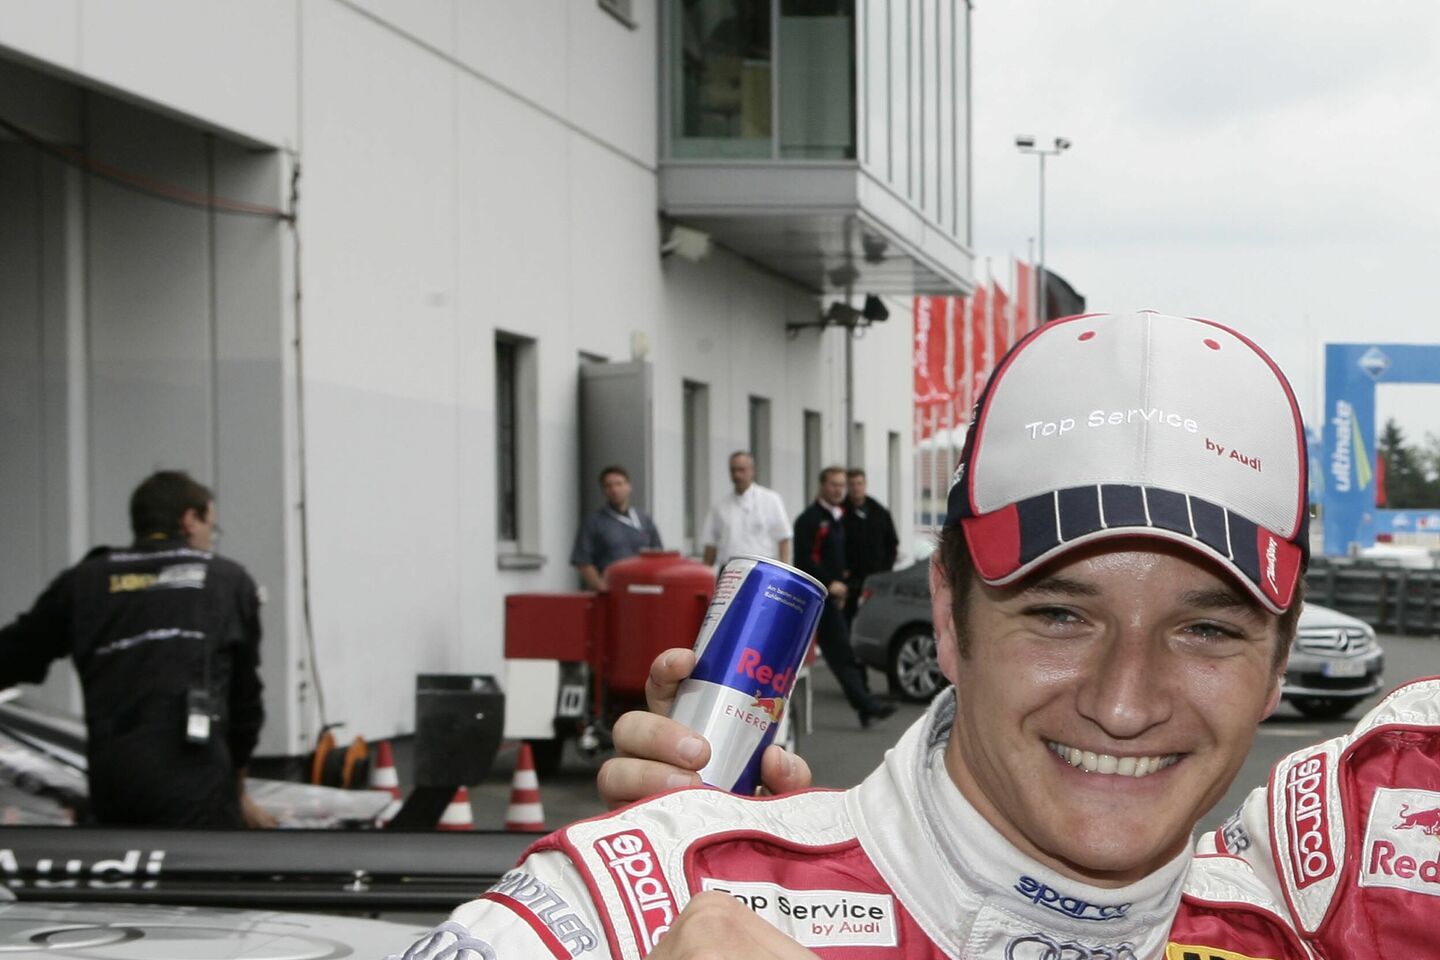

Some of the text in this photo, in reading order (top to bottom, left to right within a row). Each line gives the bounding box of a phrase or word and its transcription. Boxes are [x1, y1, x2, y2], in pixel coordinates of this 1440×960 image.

[1025, 407, 1199, 440] Top Service
[1205, 438, 1262, 472] by Audi
[1331, 400, 1351, 492] ultimate
[736, 647, 792, 693] Red
[725, 704, 768, 731] ENERG
[1287, 758, 1328, 878] sparco
[489, 872, 599, 957] NDTLER
[778, 896, 884, 920] Service
[1013, 875, 1132, 921] sparco
[811, 921, 880, 936] by Audi
